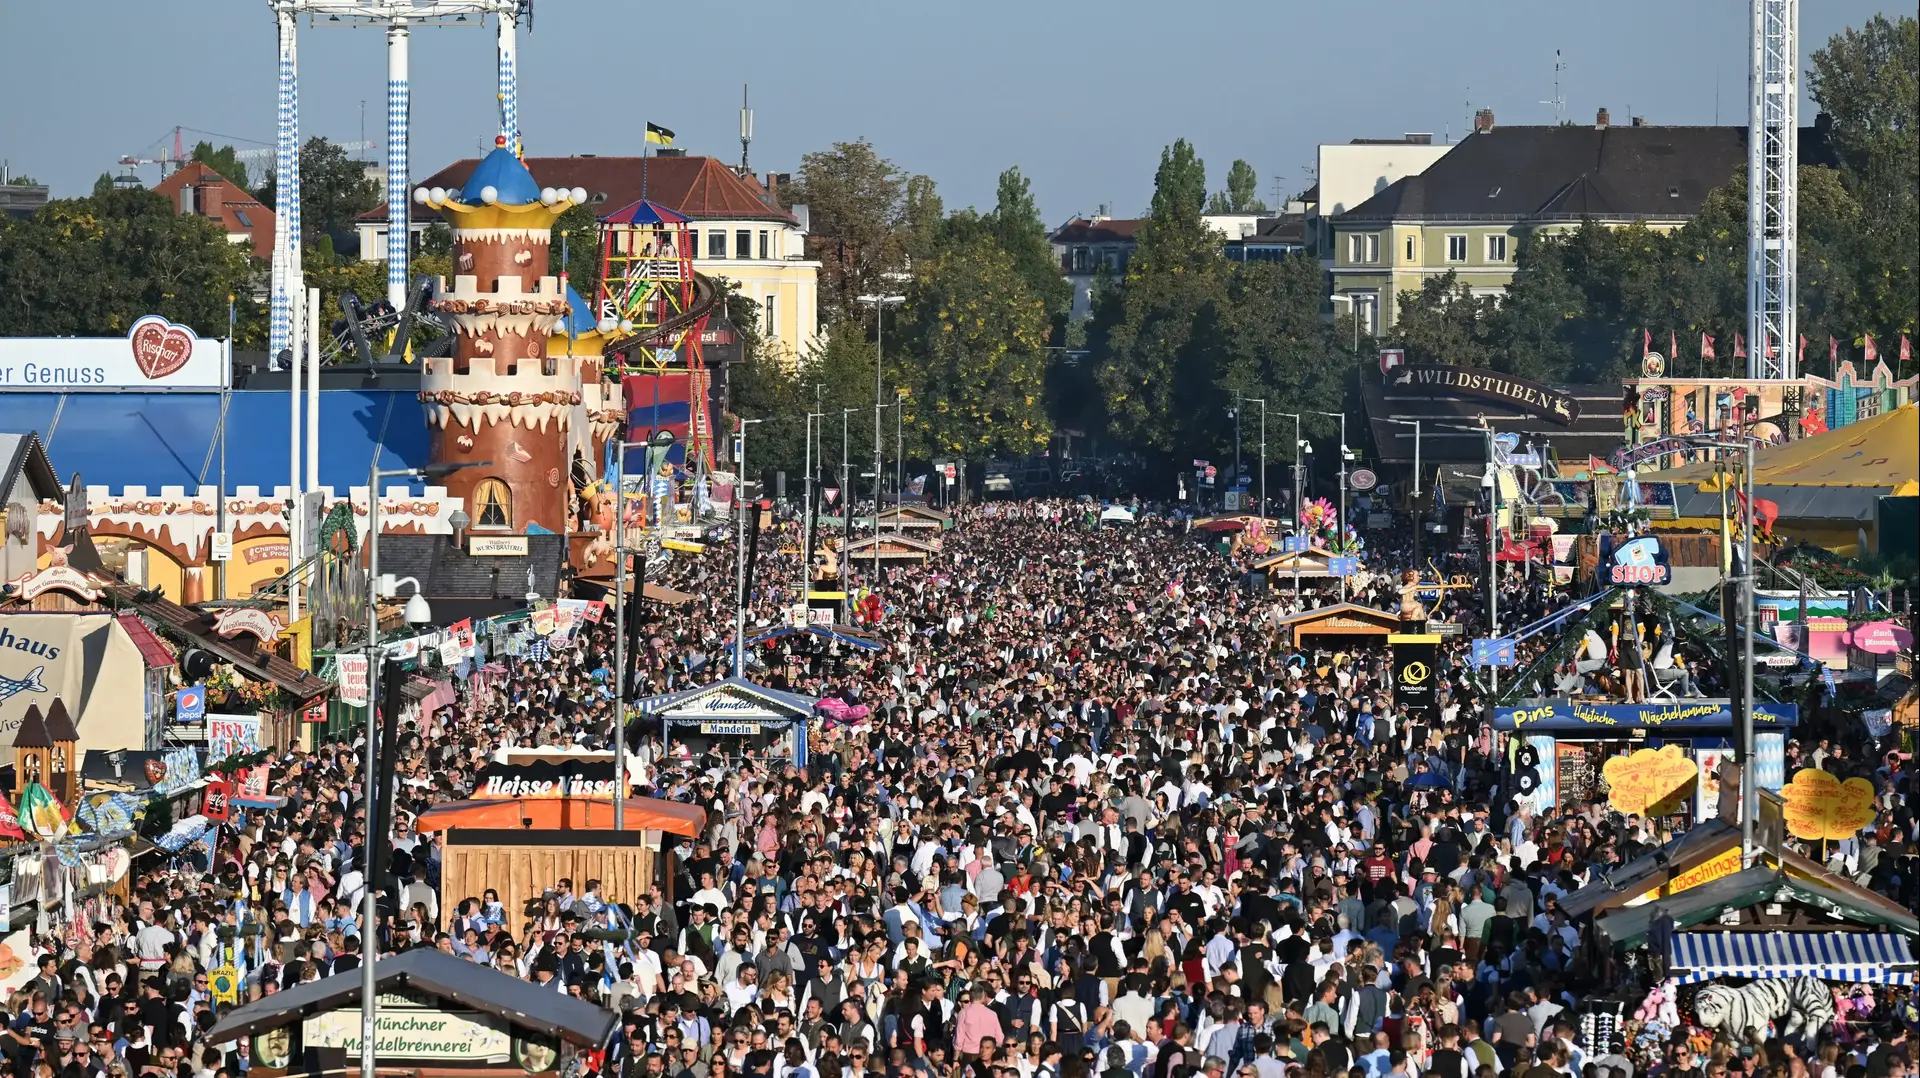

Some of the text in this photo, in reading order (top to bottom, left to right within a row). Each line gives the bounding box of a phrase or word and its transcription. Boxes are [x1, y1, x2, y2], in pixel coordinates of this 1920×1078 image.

[143, 339, 179, 362] Rischart
[0, 363, 105, 384] r Genuss
[1416, 369, 1553, 409] WILDSTUBEN
[674, 530, 694, 538] Imbiss
[255, 545, 290, 555] Champag
[1612, 564, 1665, 583] SHOP
[0, 627, 60, 660] haus
[342, 660, 368, 673] Schne
[705, 698, 758, 711] Mandeln
[178, 711, 203, 720] pepsi
[1513, 703, 1776, 728] Pins Halstücher Wäscheklammern ssen
[211, 721, 243, 738] Fish
[709, 724, 751, 734] Mandeln
[485, 773, 615, 796] Heisse Nüsse
[212, 969, 235, 977] BRAZIL
[374, 1016, 447, 1032] Münchner
[342, 1037, 472, 1053] Madelbrennerei
